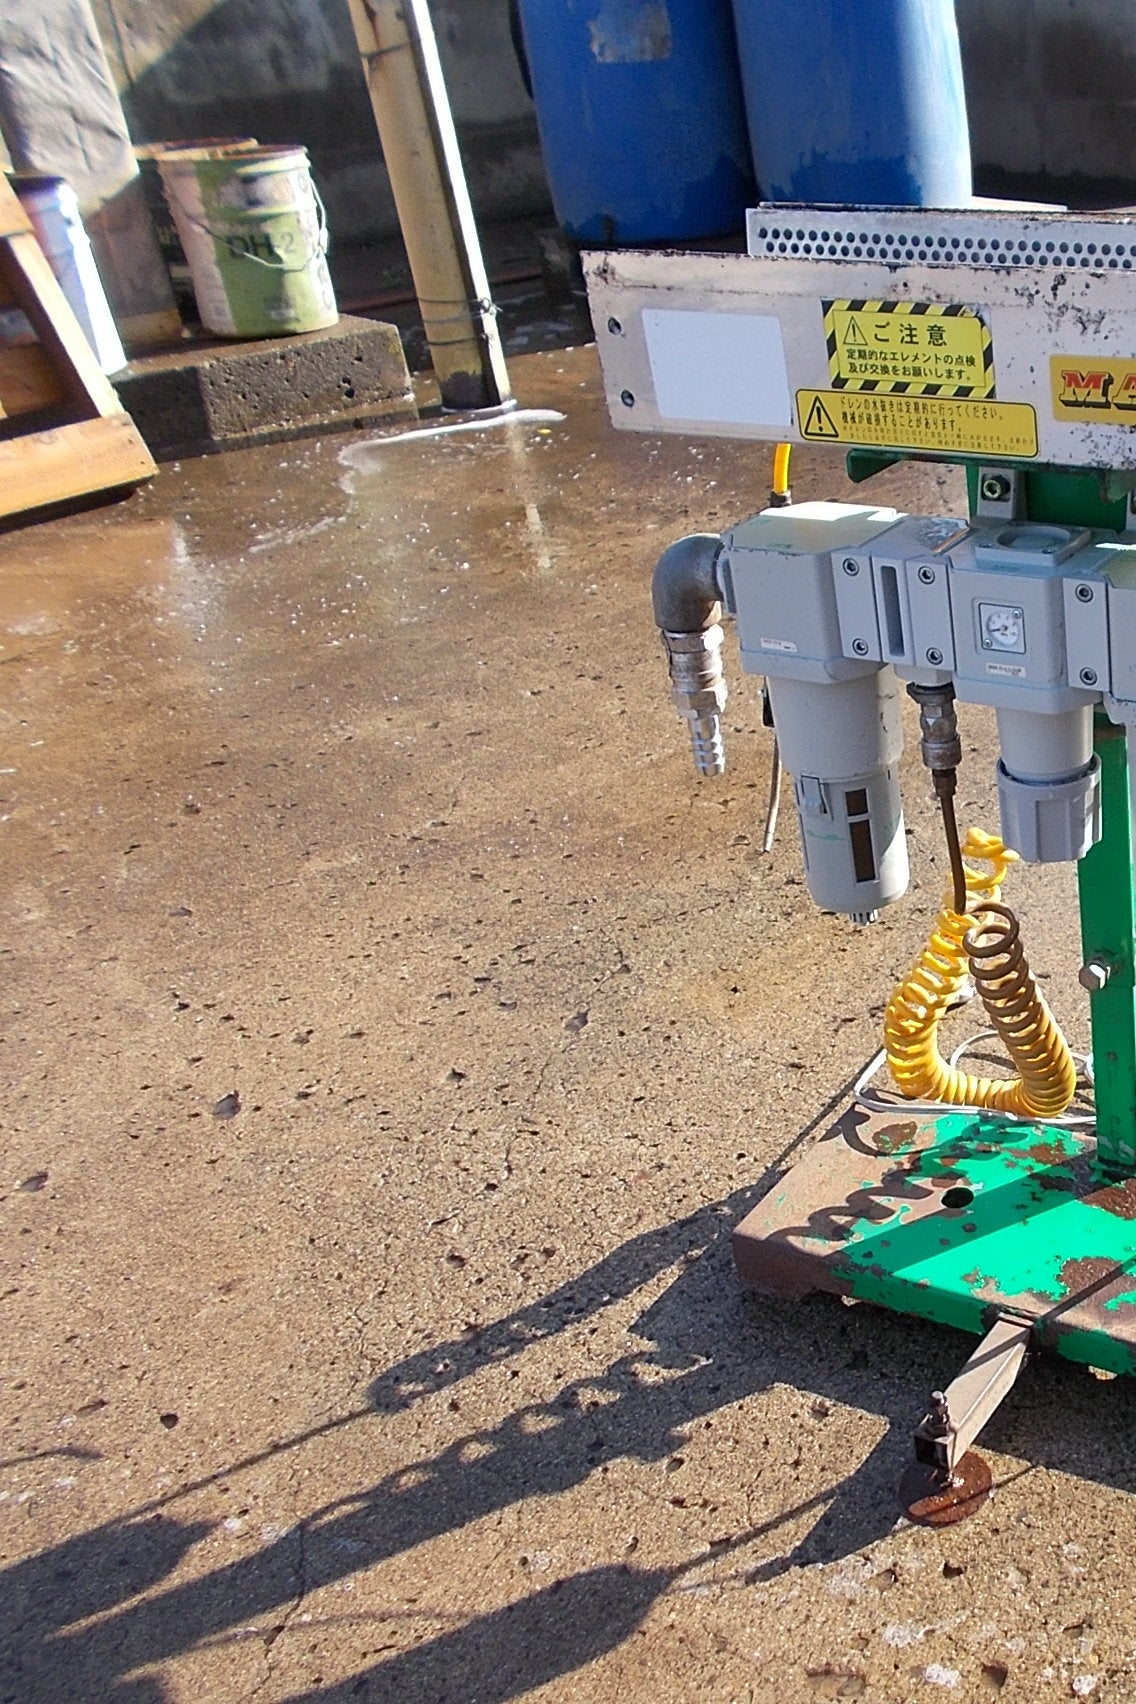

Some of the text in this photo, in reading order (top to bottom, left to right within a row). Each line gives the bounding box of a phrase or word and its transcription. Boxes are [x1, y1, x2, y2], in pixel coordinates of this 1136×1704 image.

[874, 321, 947, 346] ご注意
[846, 348, 977, 367] 定期的なエレメントの点検
[848, 362, 970, 380] 及び交換をお願いします。
